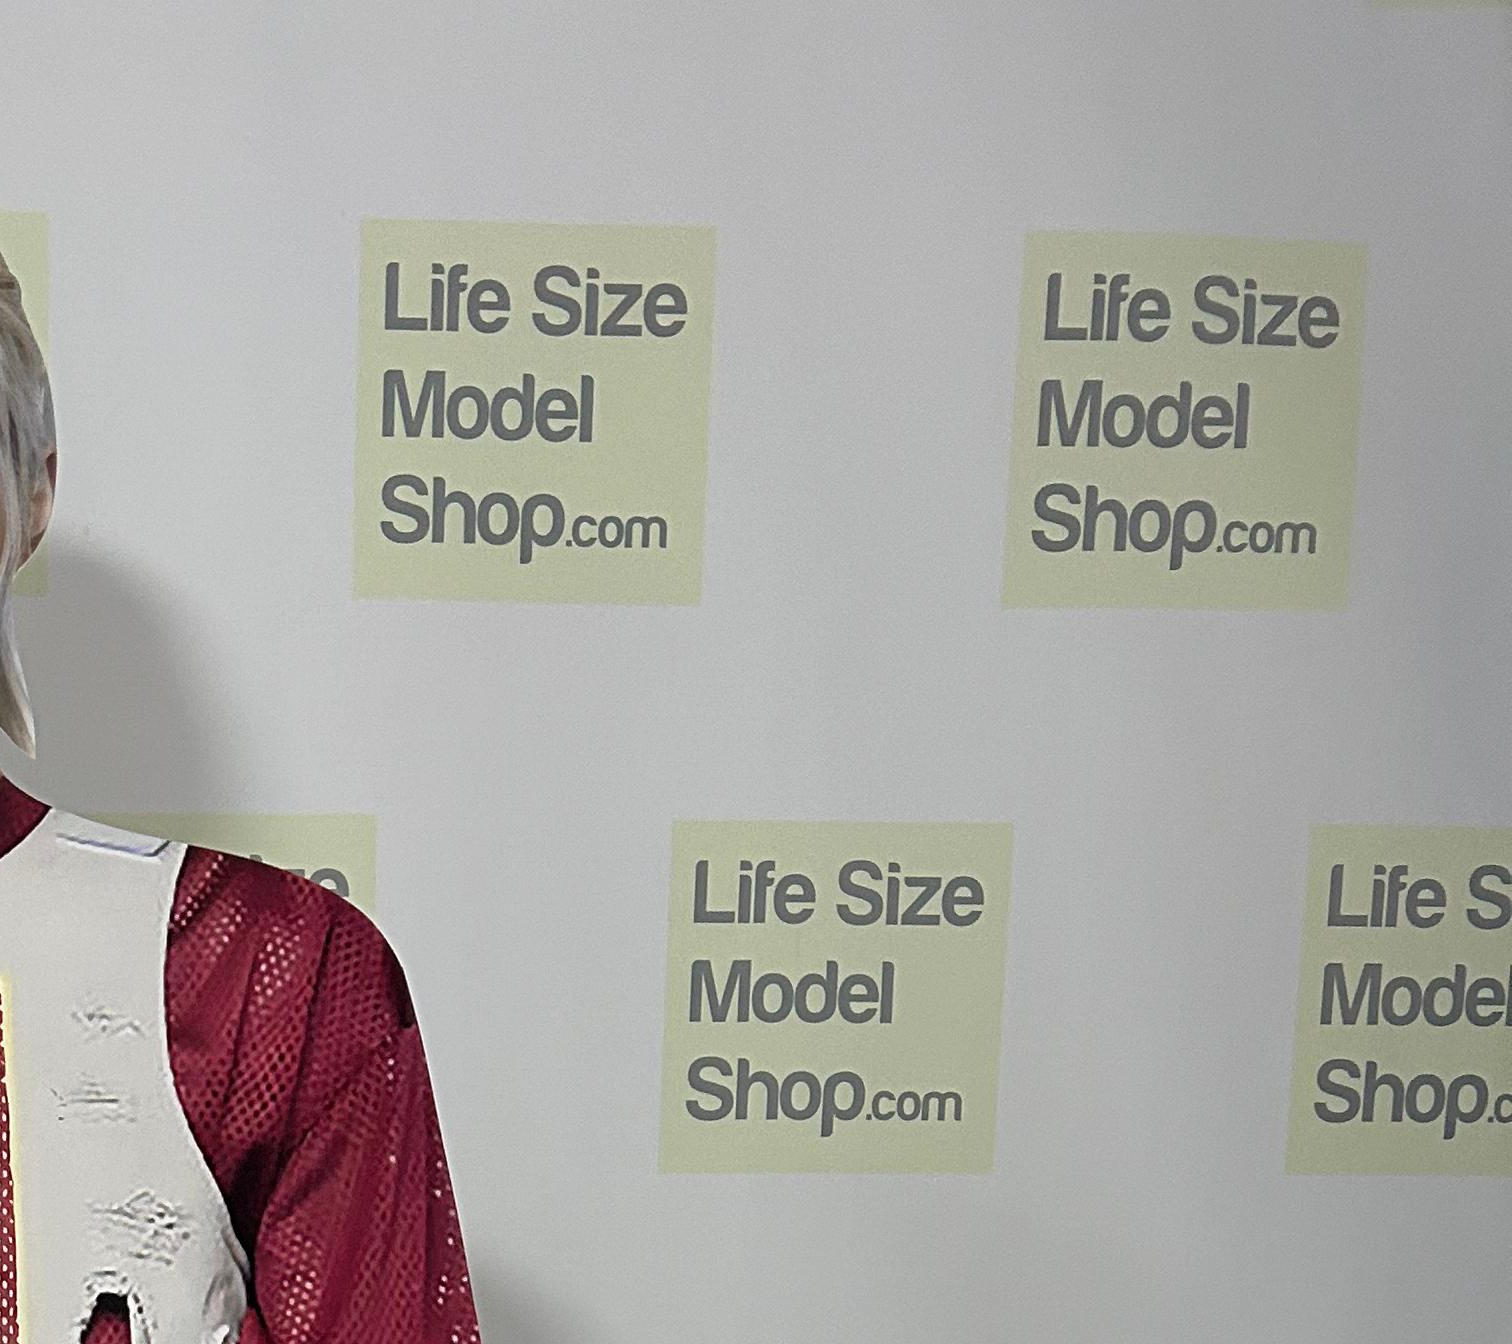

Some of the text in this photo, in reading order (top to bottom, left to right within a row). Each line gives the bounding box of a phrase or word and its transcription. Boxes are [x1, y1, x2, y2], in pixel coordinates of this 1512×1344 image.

[385, 262, 687, 337] Life Size
[1044, 273, 1339, 349] Life Size
[382, 370, 594, 442] Model
[1037, 380, 1250, 449] Model
[381, 474, 667, 564] Shop.com
[1032, 483, 1316, 570] Shop.com
[694, 860, 984, 926] Life Size
[1328, 864, 1446, 928] Life
[689, 960, 894, 1024] Model
[686, 1057, 962, 1137] Shop.com
[1314, 1059, 1512, 1140] Shop.c
